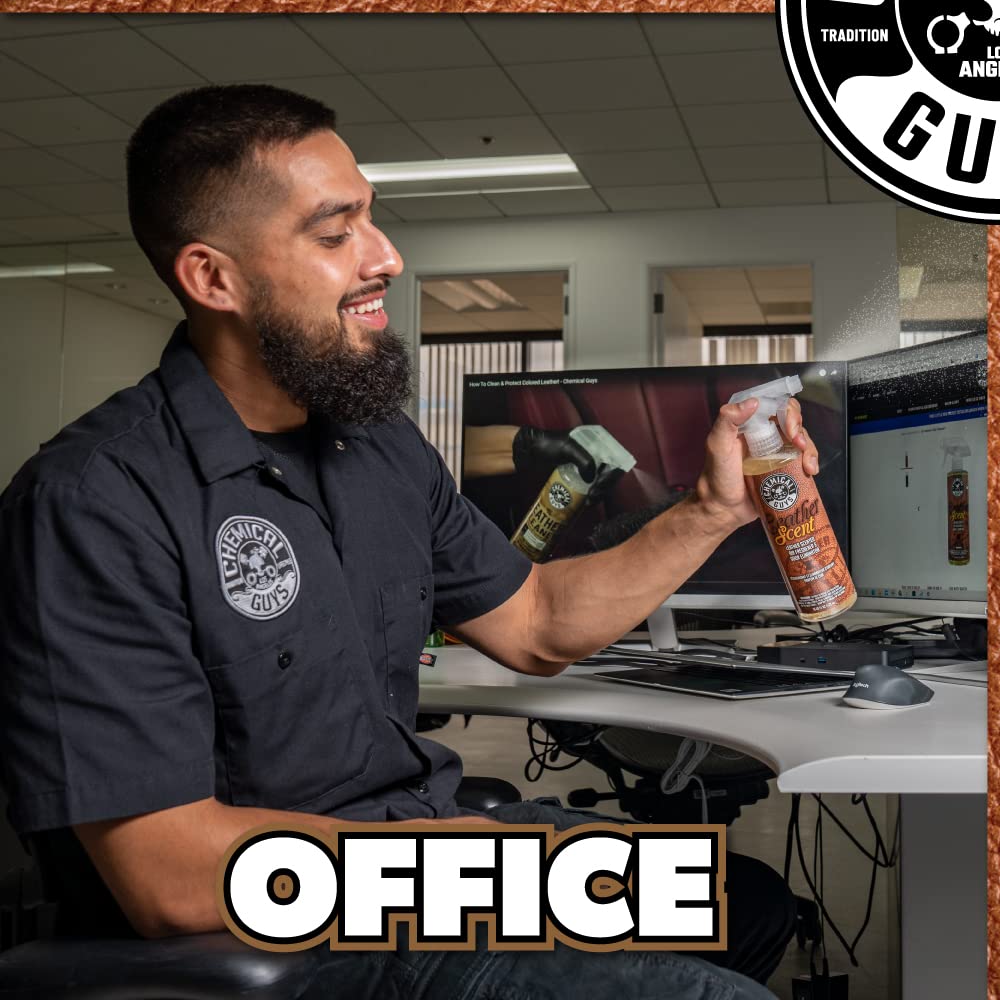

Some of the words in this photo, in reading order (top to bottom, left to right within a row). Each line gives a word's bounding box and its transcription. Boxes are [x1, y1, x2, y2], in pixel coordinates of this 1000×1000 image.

[763, 476, 795, 497] CHEMICAL
[773, 497, 793, 508] GUYS
[775, 516, 815, 546] Scent
[222, 522, 284, 578] CHEMICAL
[251, 584, 289, 611] GUYS
